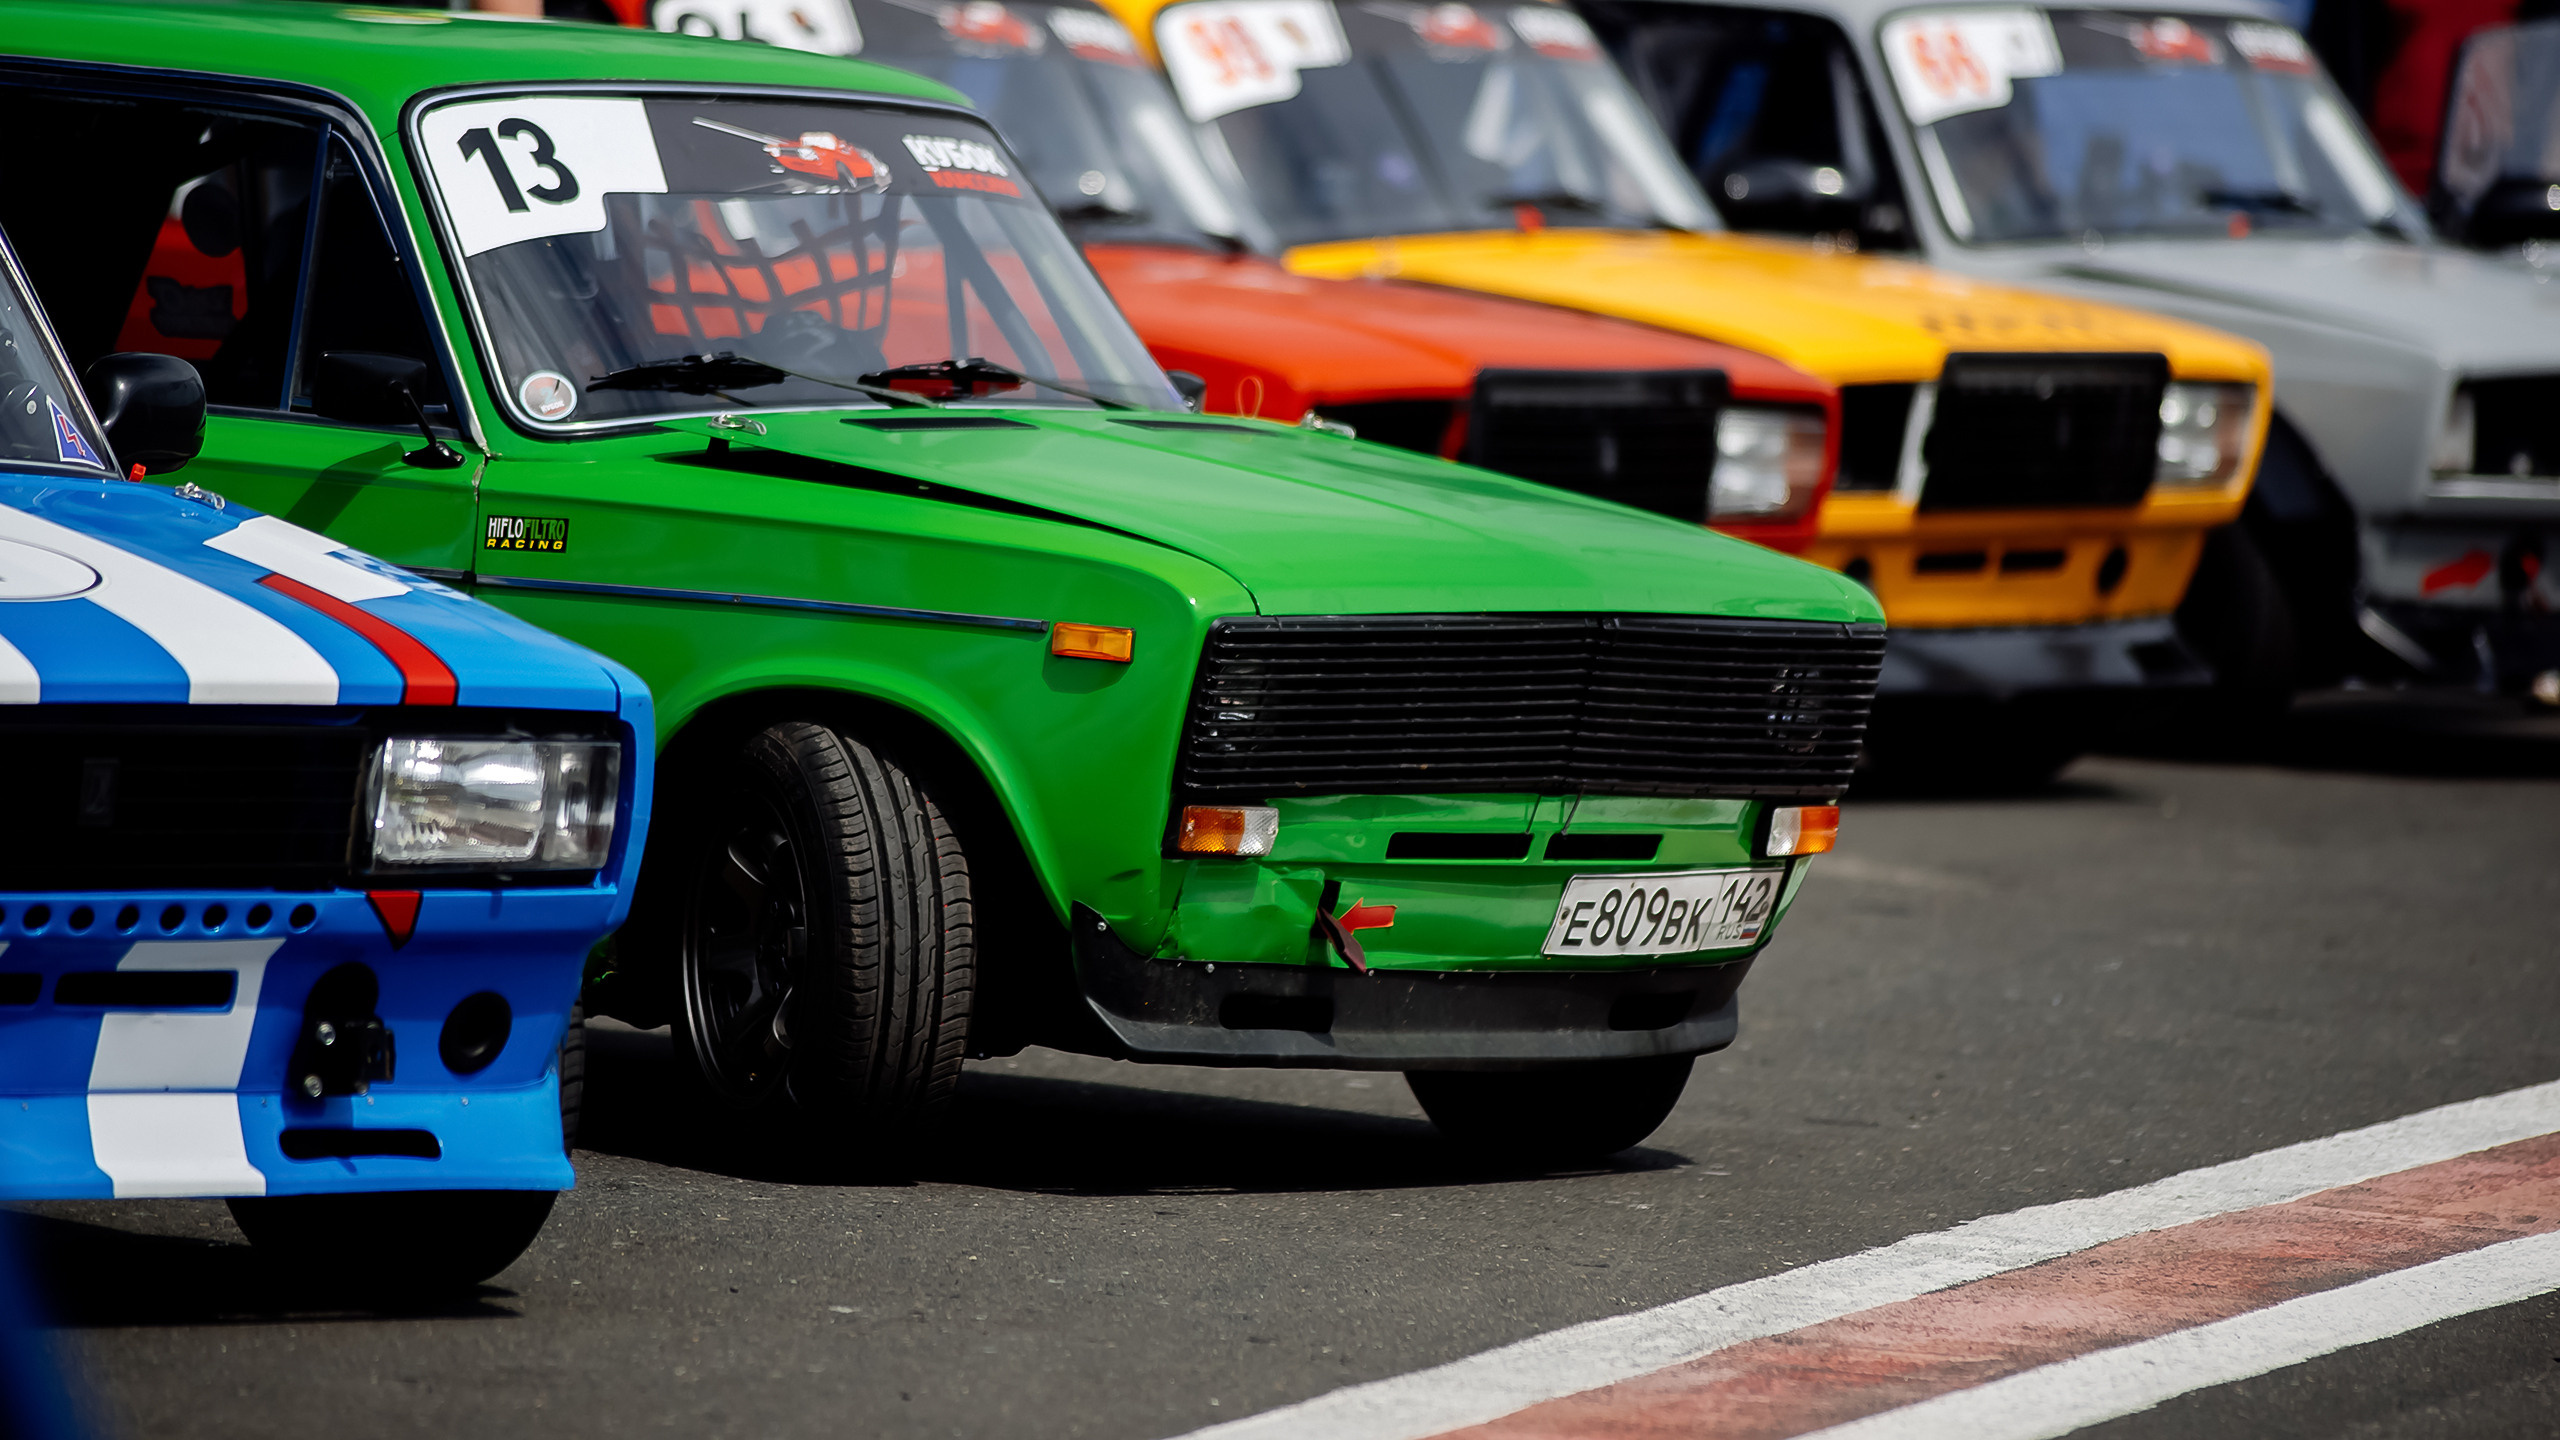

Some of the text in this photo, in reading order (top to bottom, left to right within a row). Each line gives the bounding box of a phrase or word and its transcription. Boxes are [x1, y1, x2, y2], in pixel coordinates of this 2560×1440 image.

[457, 117, 580, 213] 13
[901, 134, 1009, 177] КУБОК
[486, 538, 564, 550] RACING
[488, 517, 566, 540] HIFLOFILTRO
[1721, 877, 1771, 923] 142
[1716, 924, 1742, 940] RUS
